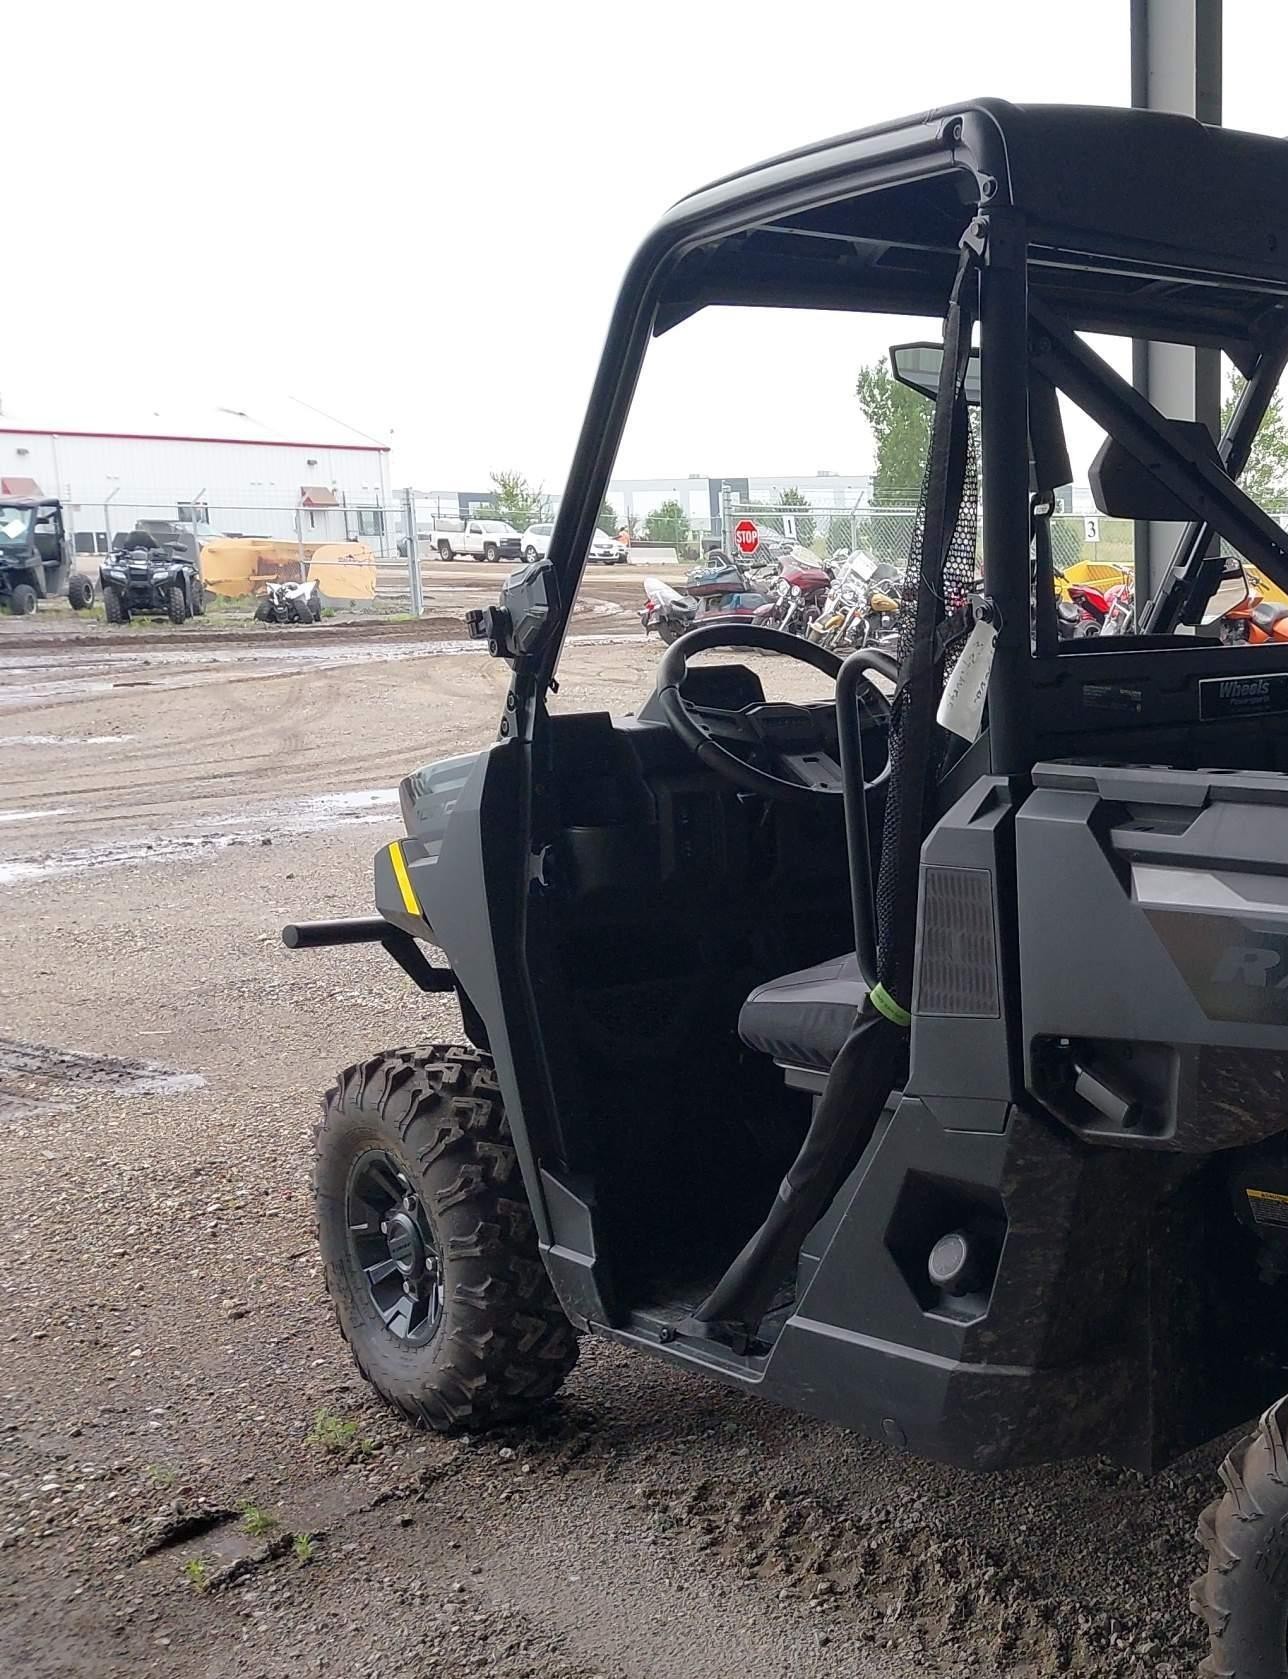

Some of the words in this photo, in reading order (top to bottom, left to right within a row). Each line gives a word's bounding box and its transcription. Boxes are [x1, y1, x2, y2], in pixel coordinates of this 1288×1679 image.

[736, 530, 758, 545] STOP
[1087, 520, 1096, 538] 3
[1219, 680, 1270, 698] Wheels
